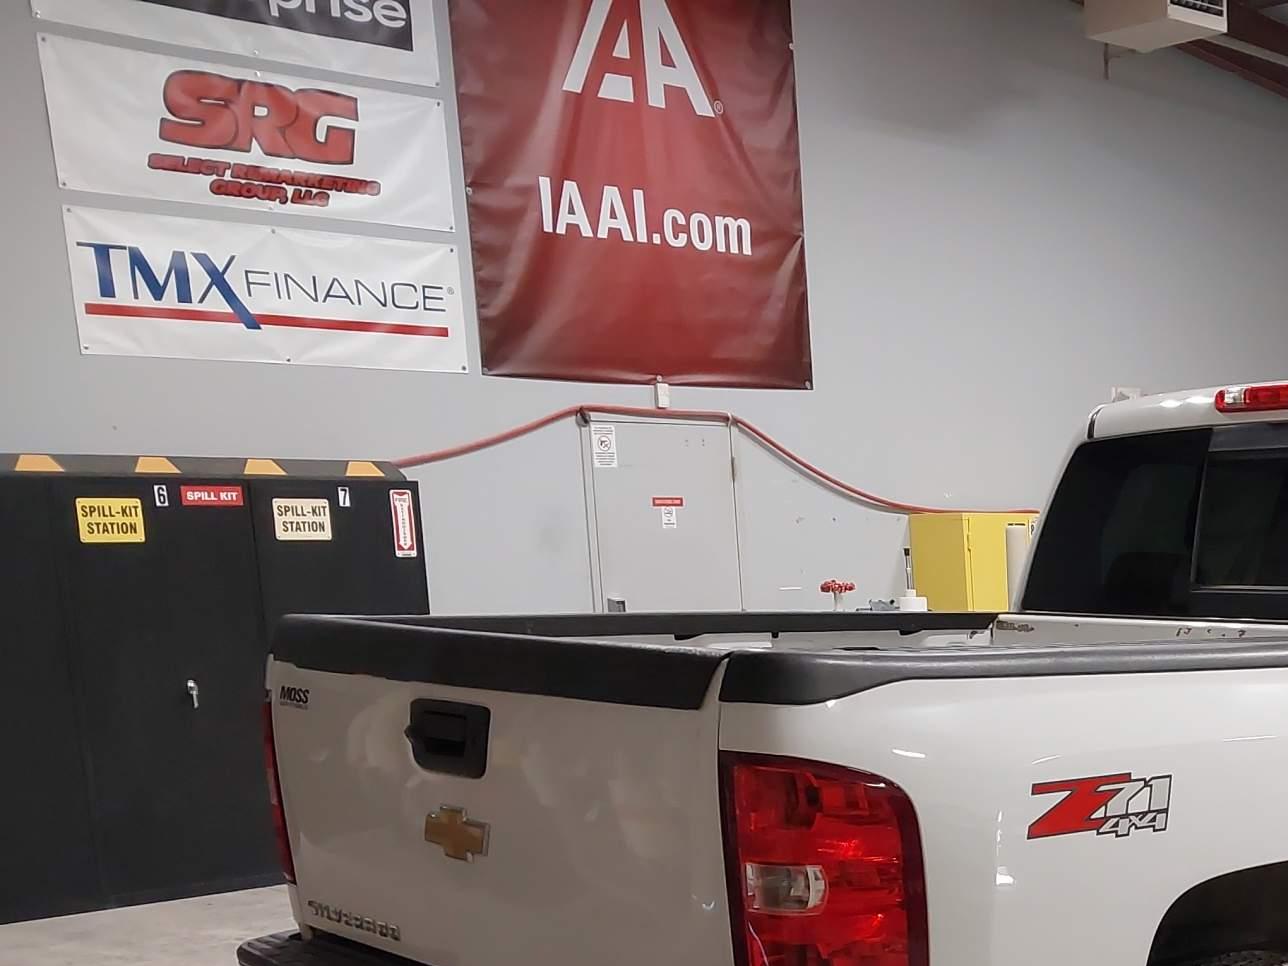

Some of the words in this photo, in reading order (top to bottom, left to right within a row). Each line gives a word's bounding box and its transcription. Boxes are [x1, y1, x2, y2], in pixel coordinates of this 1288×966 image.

[159, 69, 359, 165] SRG
[148, 153, 231, 177] SELECT
[210, 179, 288, 205] GROUP,
[538, 175, 752, 256] IAAI.com
[76, 241, 262, 330] TMX
[156, 486, 167, 505] 6
[186, 491, 218, 501] SPILL
[219, 491, 238, 501] KIT
[339, 488, 348, 505] 7
[80, 505, 139, 518] SPILL-KIT
[276, 504, 327, 517] SPILL-KIT
[87, 522, 138, 535] STATION
[282, 520, 326, 533] STATION
[279, 685, 310, 704] MOSS
[1027, 772, 1172, 840] Z71
